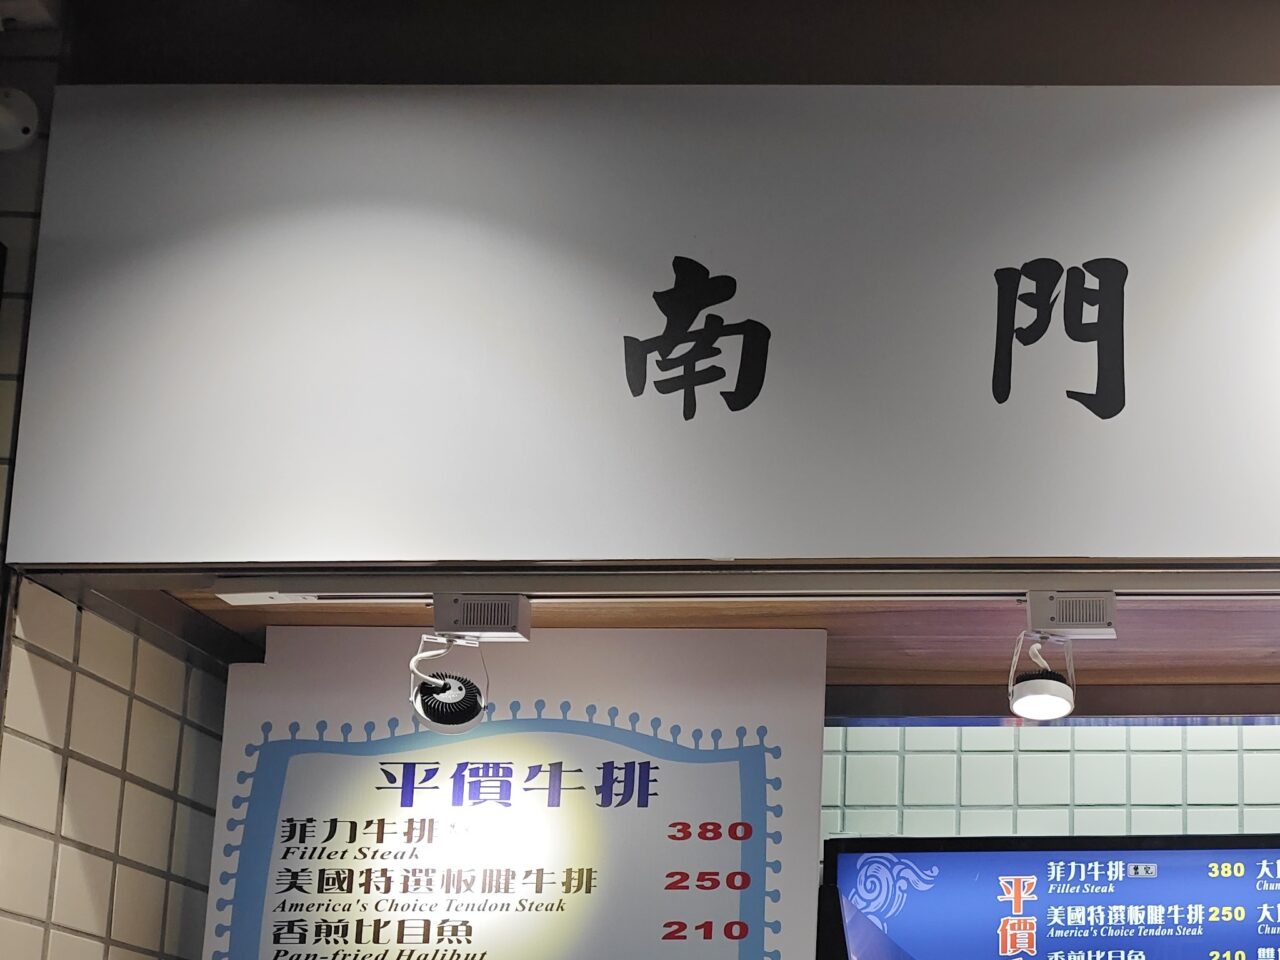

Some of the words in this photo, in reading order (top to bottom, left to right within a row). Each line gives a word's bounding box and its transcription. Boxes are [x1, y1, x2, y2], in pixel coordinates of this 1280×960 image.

[375, 761, 660, 808] 平價牛排
[280, 818, 437, 844] 菲力牛排
[667, 822, 753, 840] 380
[280, 847, 349, 860] Fillet
[353, 847, 420, 860] Steak
[275, 867, 598, 895] 美國特選板腱牛排
[664, 871, 751, 890] 250
[1047, 860, 1126, 882] 菲力牛排
[1208, 862, 1245, 878] 380
[1048, 883, 1081, 894] Fillet
[1082, 883, 1115, 894] Steak
[272, 899, 368, 913] America's
[374, 899, 438, 913] Choice
[443, 899, 512, 913] Tendon
[515, 898, 567, 912] Steak
[1047, 904, 1205, 926] 美國特選板腱牛排
[1208, 906, 1246, 921] 250
[272, 918, 473, 945] 香煎比目魚
[661, 921, 749, 940] 210
[1046, 926, 1097, 938] America's
[1100, 926, 1135, 937] Choice
[1138, 925, 1173, 937] Tendon
[1175, 925, 1204, 936] Steak
